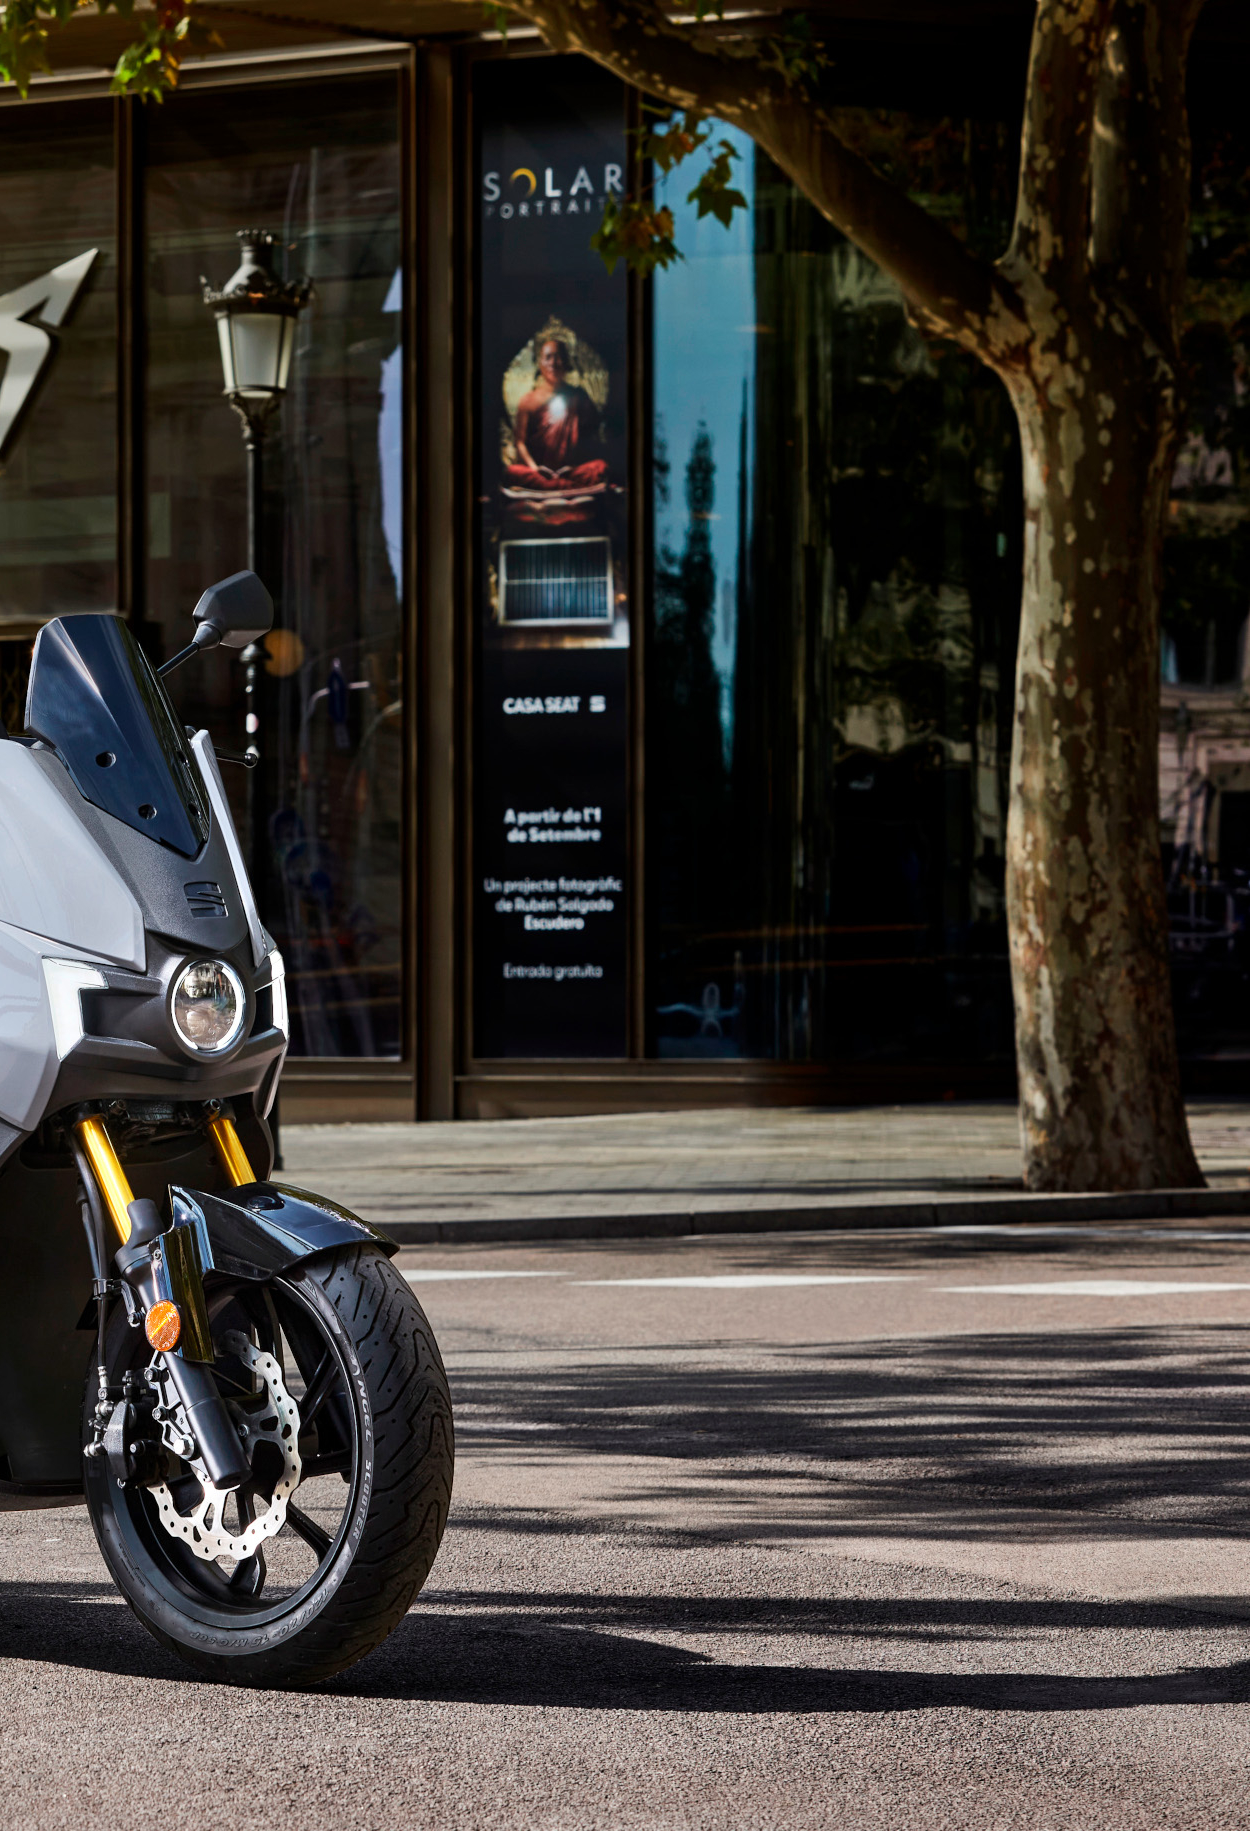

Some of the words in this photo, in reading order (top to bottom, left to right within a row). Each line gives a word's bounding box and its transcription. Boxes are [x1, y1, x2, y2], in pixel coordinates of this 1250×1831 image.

[484, 163, 623, 201] SOLAR
[485, 197, 622, 219] PORTRAIT
[503, 697, 544, 714] CASA
[545, 696, 581, 713] SEAT
[504, 808, 517, 824] A
[517, 807, 561, 826] partir
[562, 807, 582, 823] de
[507, 828, 527, 842] de
[484, 878, 502, 893] Un
[495, 898, 513, 912] de
[503, 963, 552, 979] Entrada
[352, 1459, 372, 1541] SCOOTER
